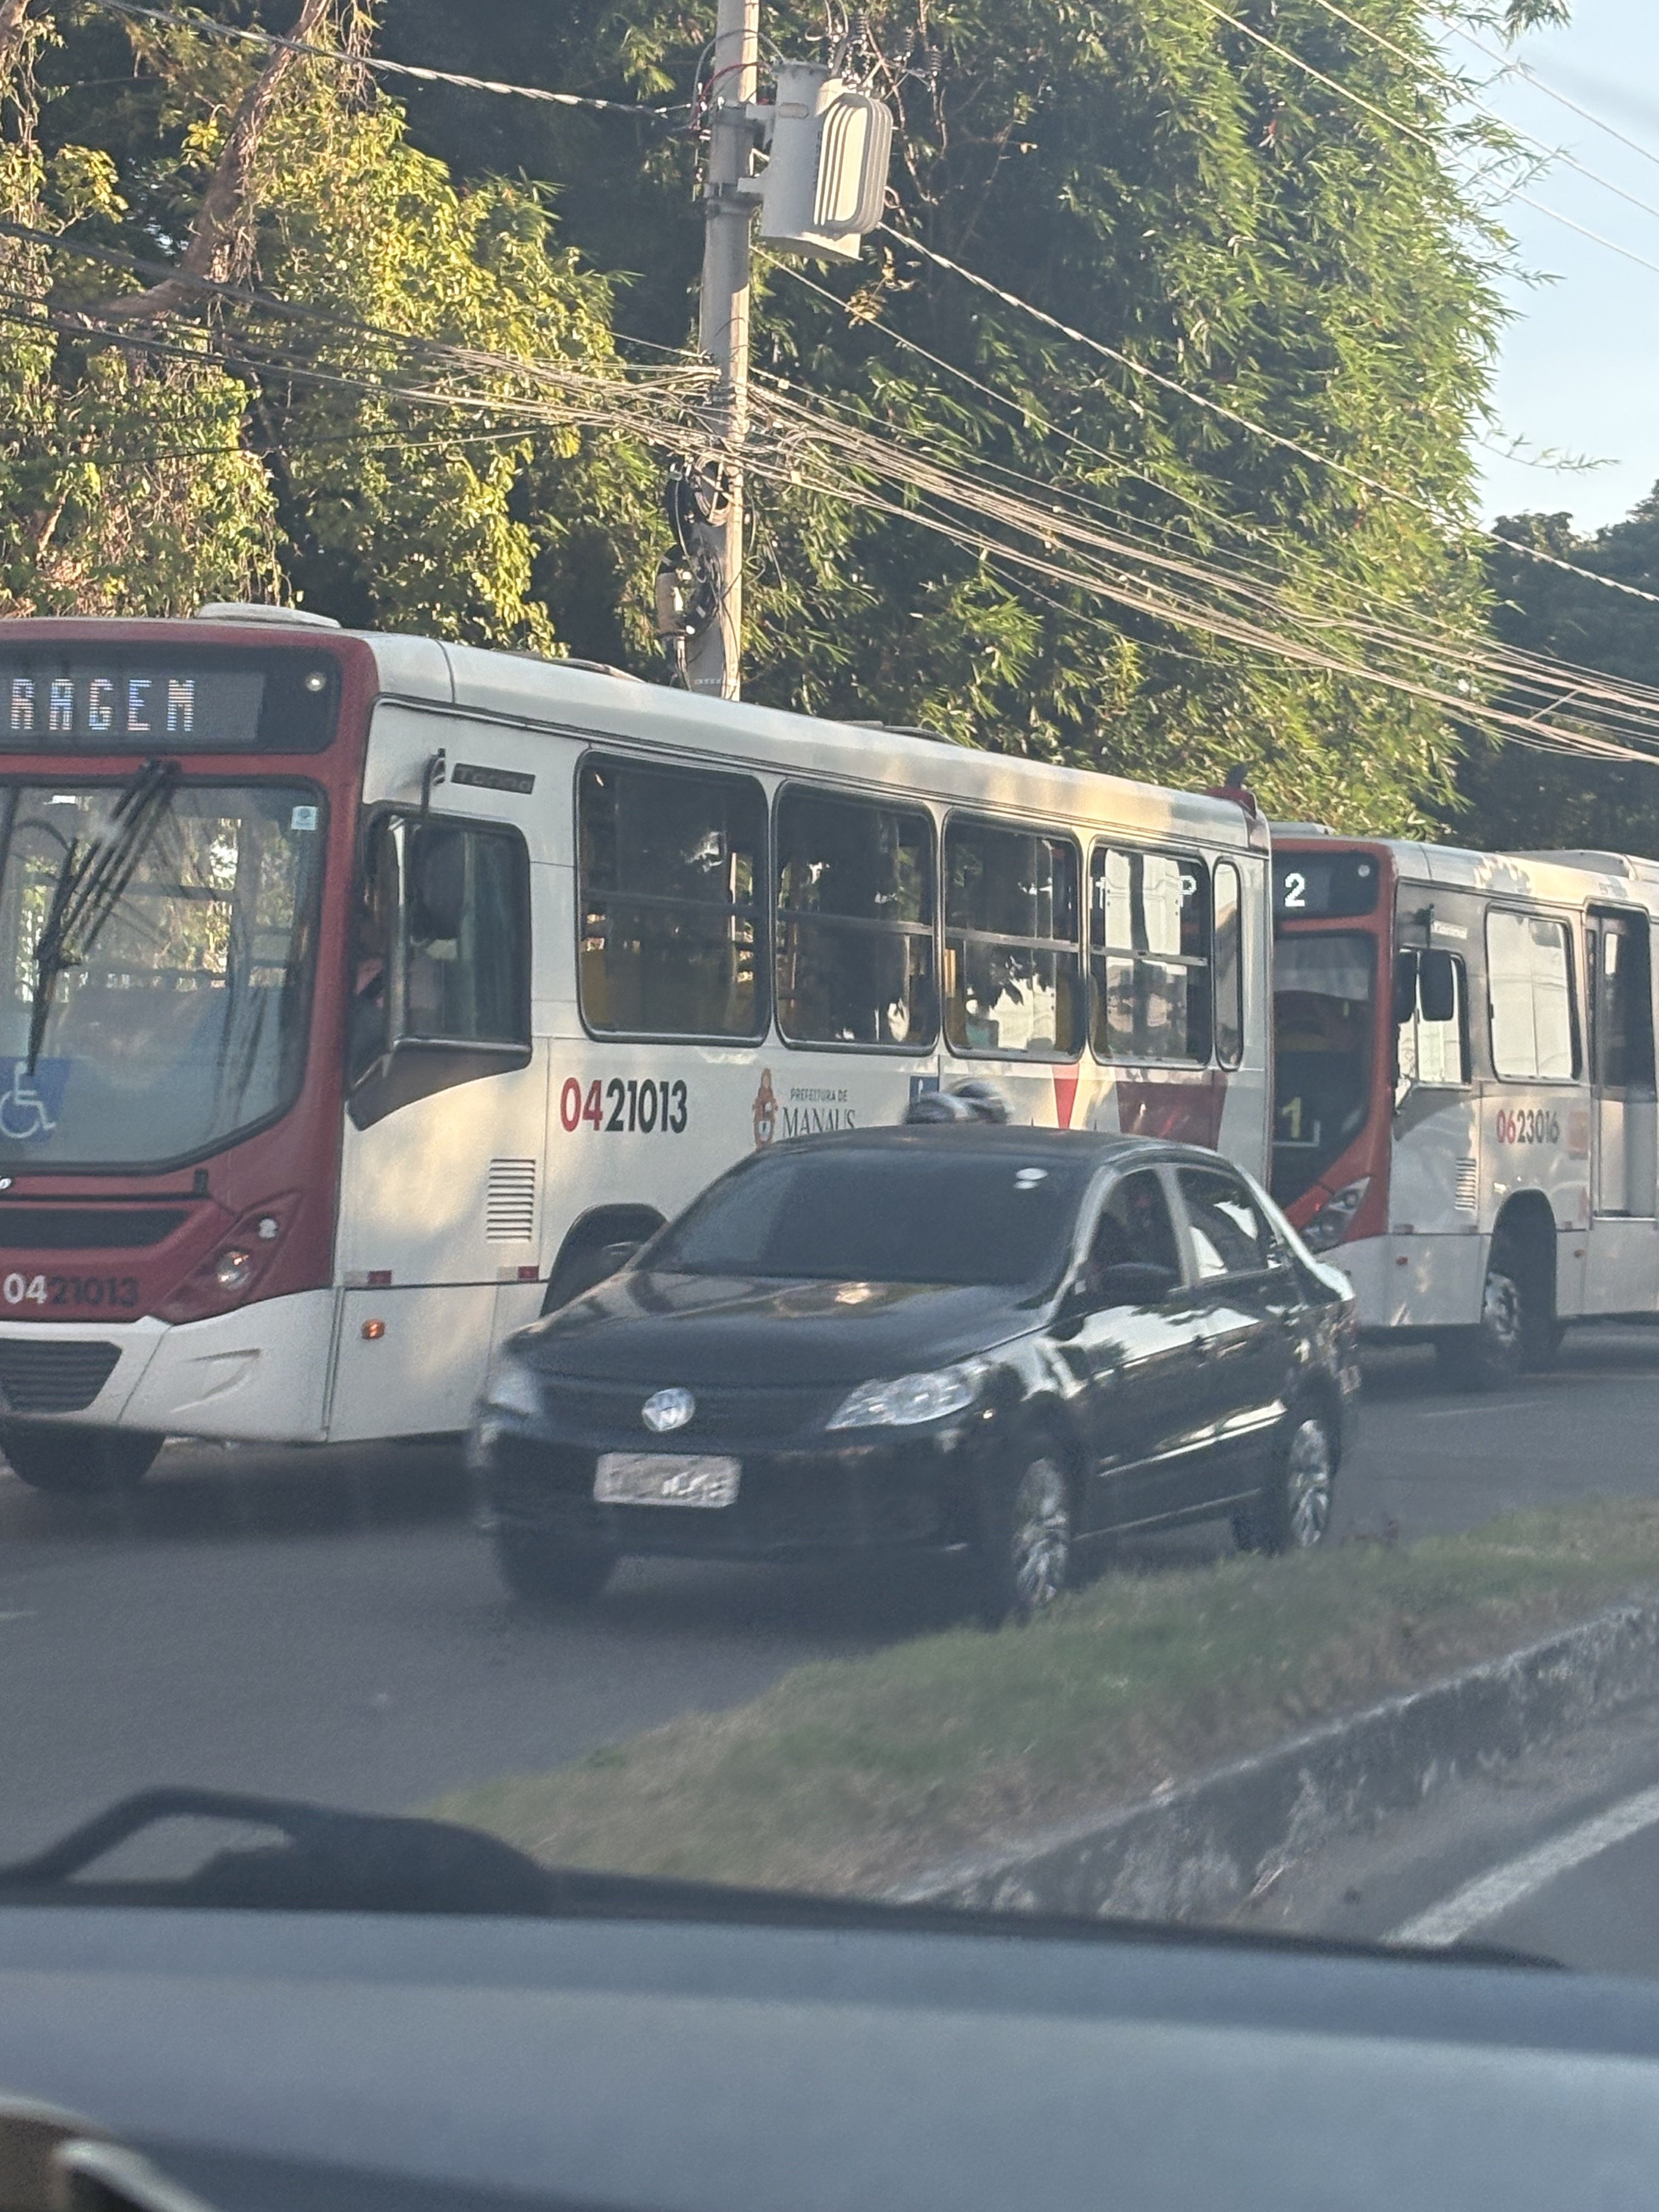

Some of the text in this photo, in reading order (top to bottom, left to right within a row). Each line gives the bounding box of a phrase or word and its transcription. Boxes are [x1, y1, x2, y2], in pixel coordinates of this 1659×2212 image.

[10, 678, 195, 731] RAGEM
[1285, 873, 1305, 907] 2
[560, 1077, 687, 1134] 0421013
[782, 1107, 855, 1138] MANAUS
[1282, 1097, 1301, 1139] 1
[1496, 1109, 1560, 1144] 0623016
[3, 1273, 139, 1308] 0421013
